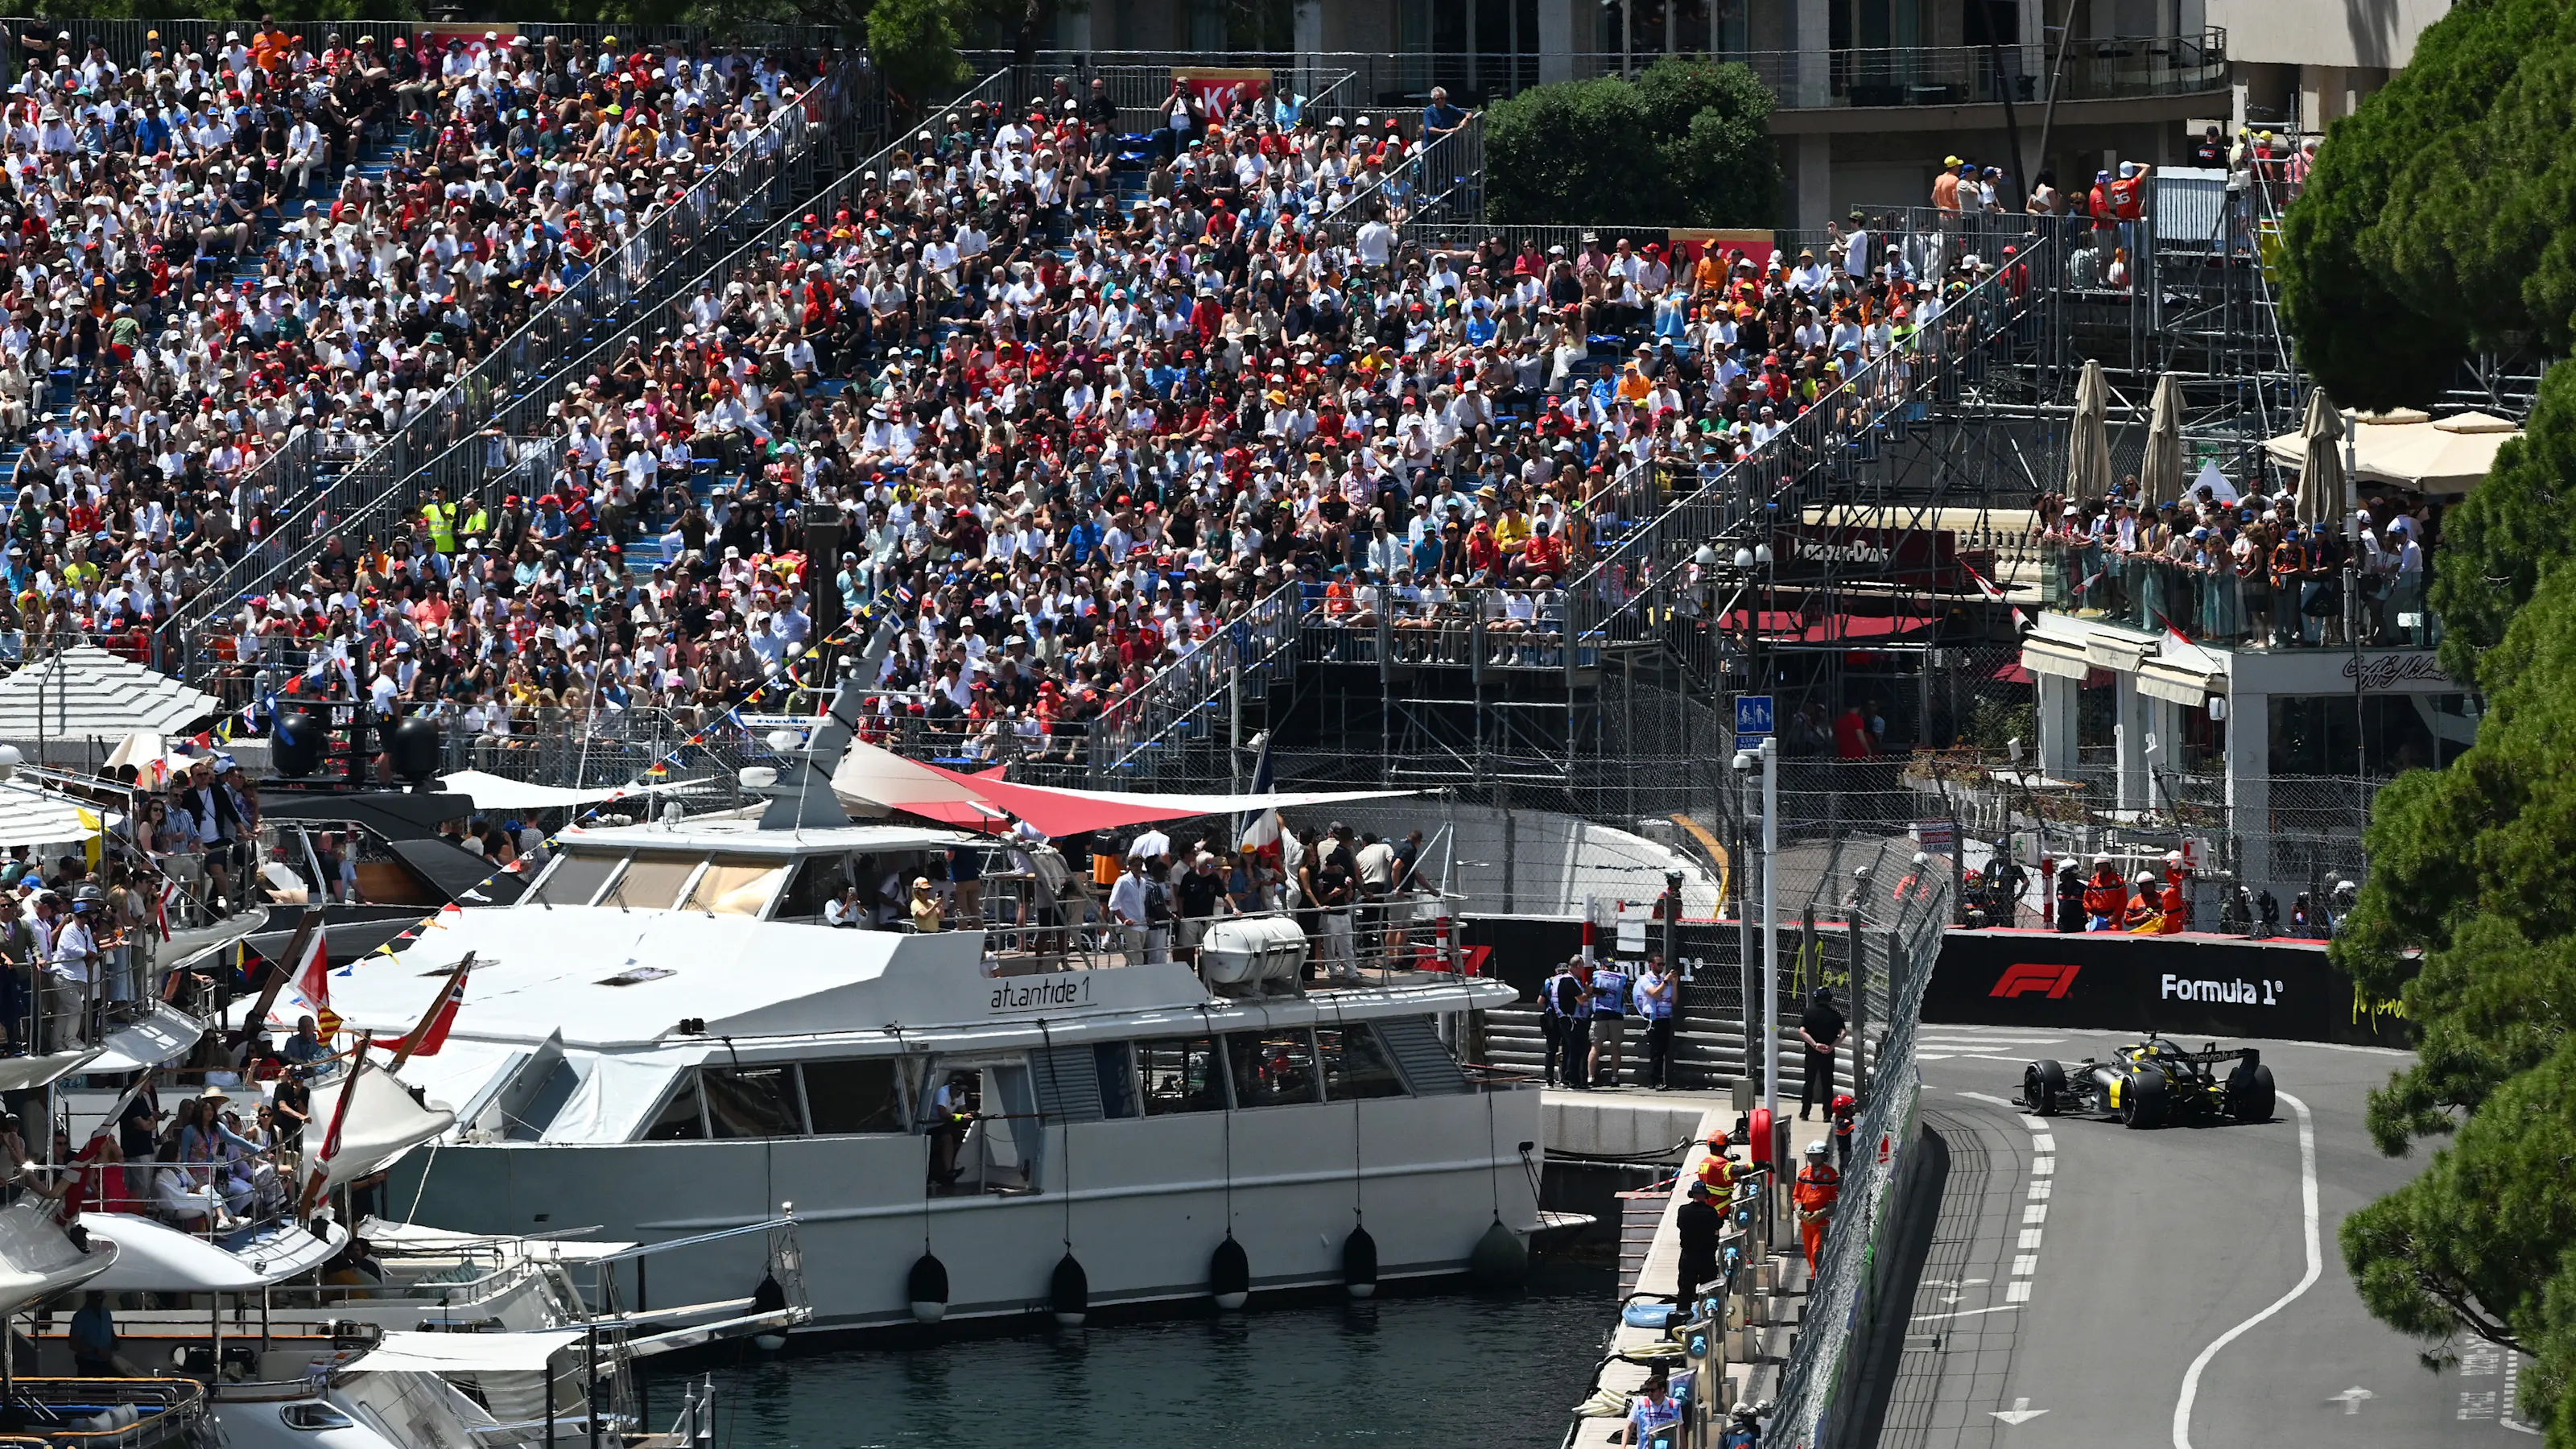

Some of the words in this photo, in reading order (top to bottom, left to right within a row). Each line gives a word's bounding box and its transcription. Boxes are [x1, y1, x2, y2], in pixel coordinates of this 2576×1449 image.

[2113, 192, 2131, 204] 16
[2380, 655, 2450, 688] Milano
[1082, 976, 1090, 1001] 1
[1988, 964, 2082, 999] F1
[2161, 974, 2257, 1004] Formula
[2189, 1051, 2238, 1062] Revolut
